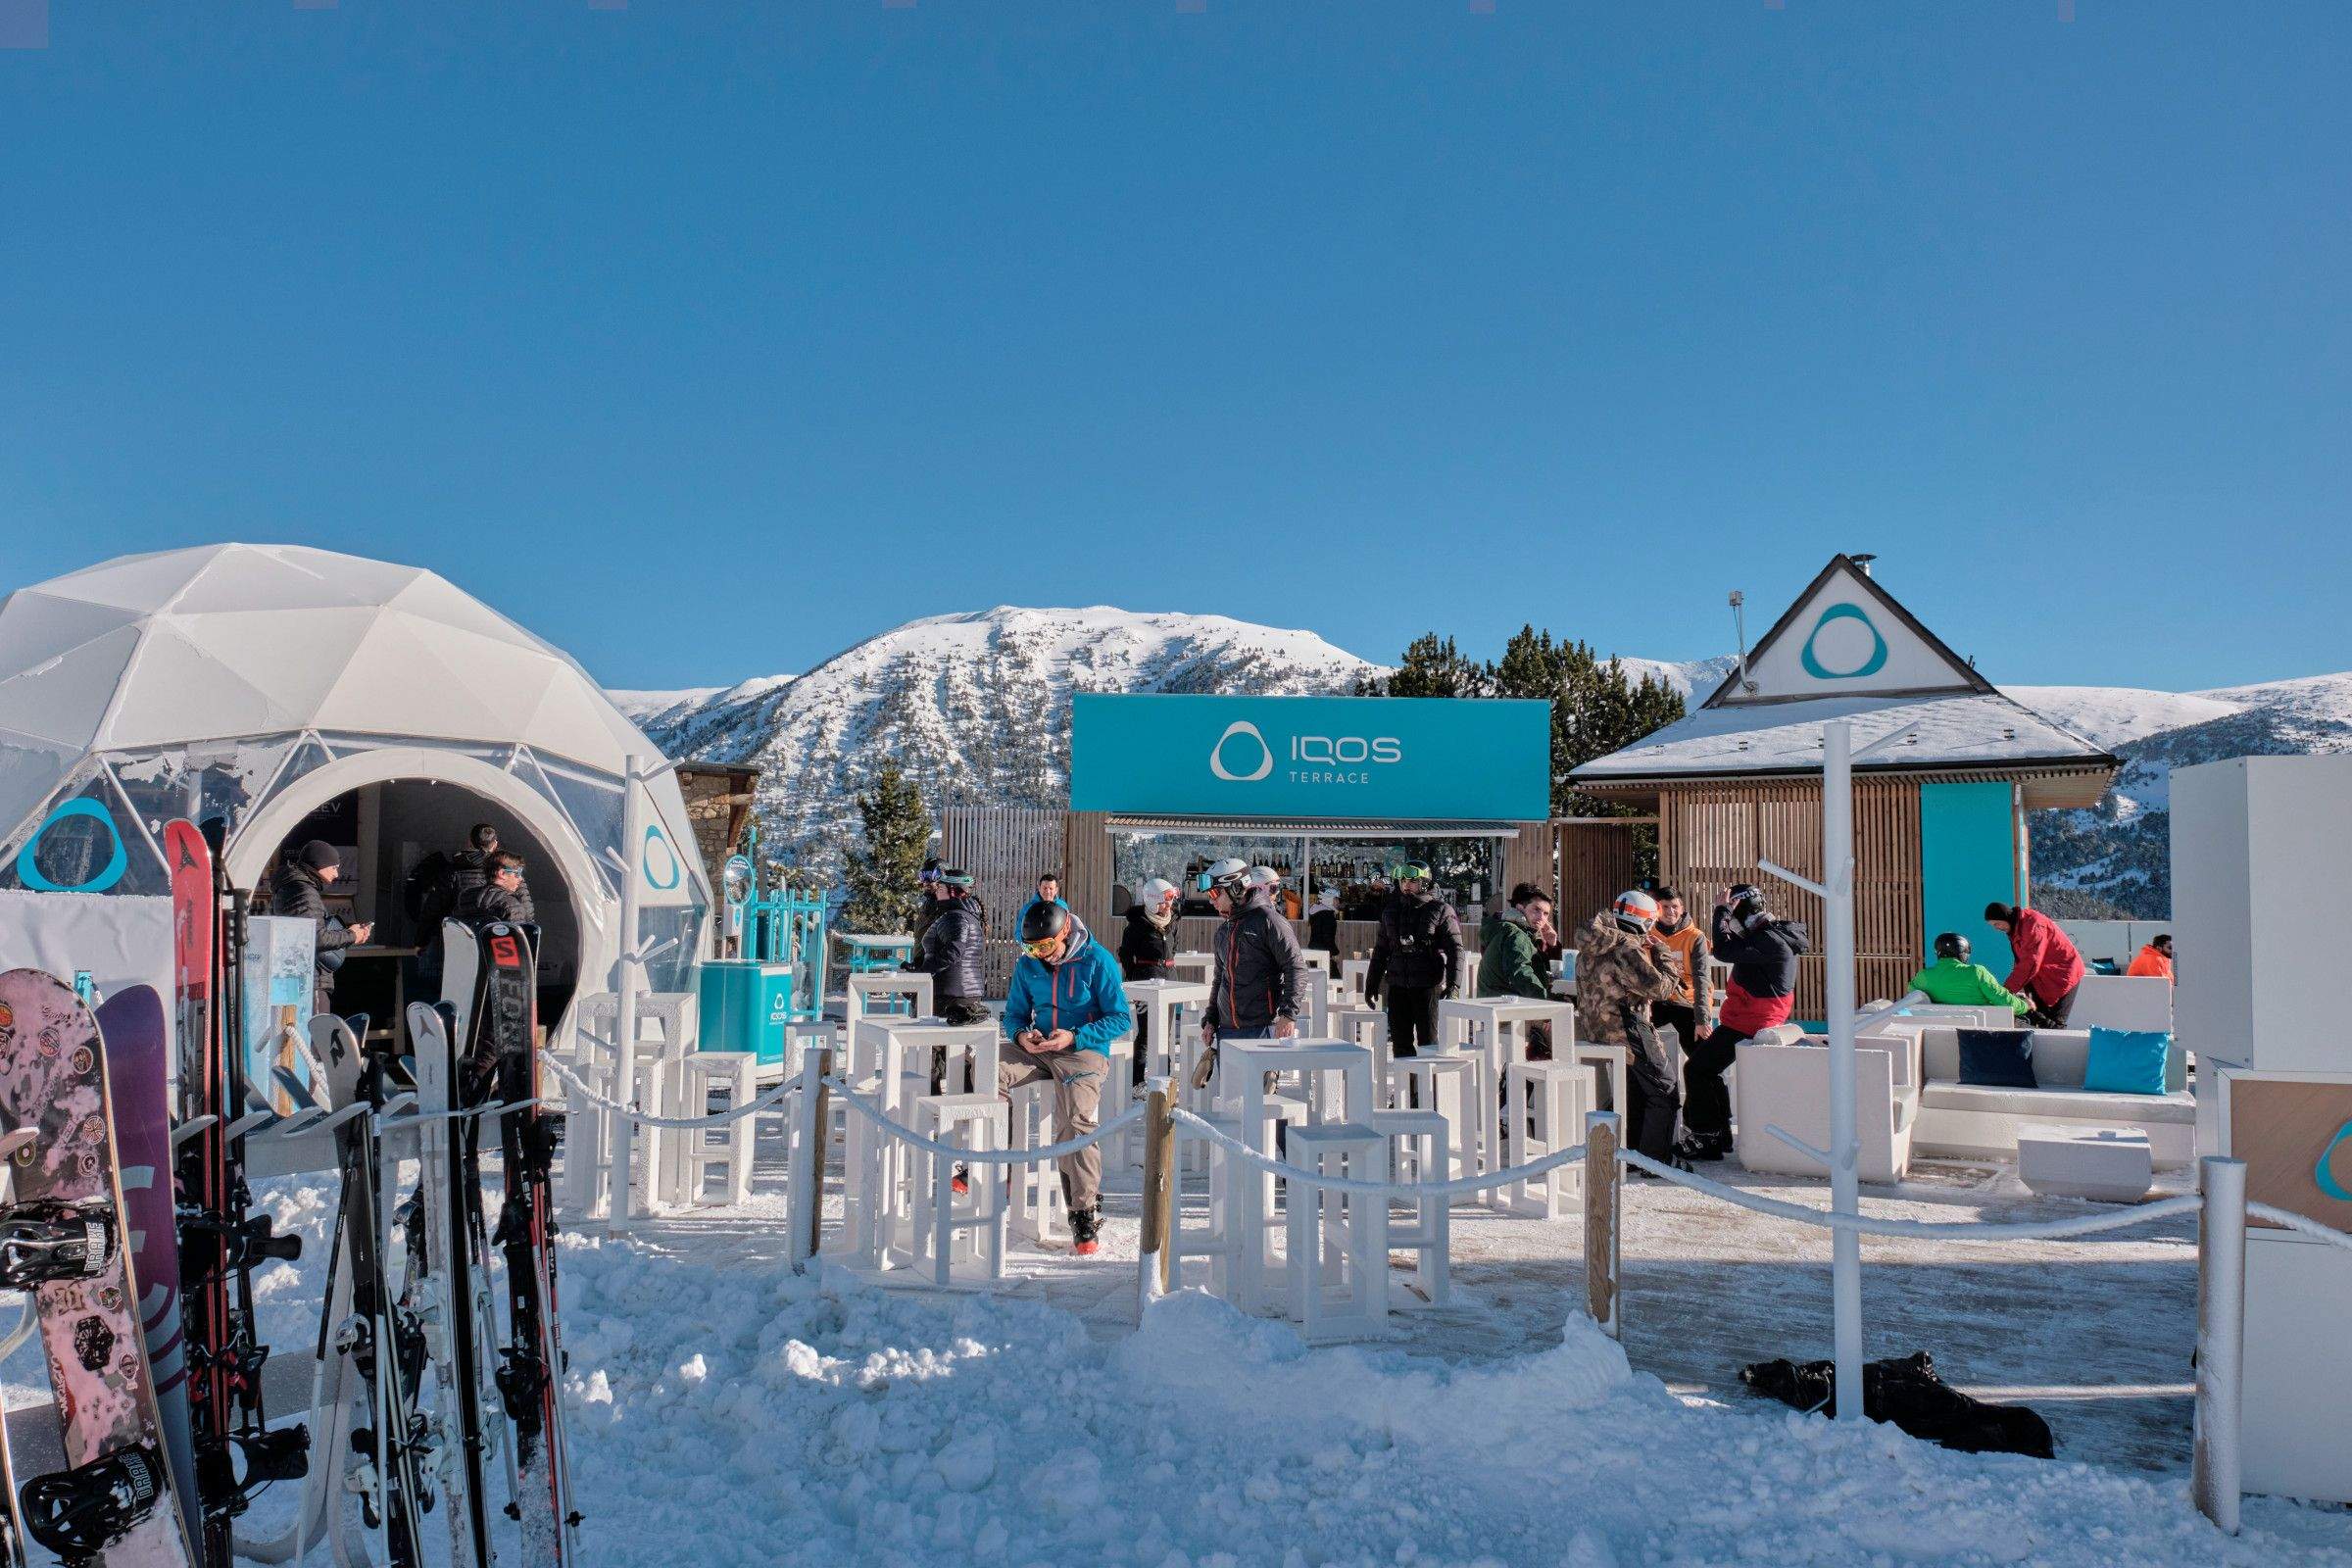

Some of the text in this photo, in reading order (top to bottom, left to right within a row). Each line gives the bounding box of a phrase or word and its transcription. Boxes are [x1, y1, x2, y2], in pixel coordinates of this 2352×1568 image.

[1292, 736, 1402, 766] IQOS
[1290, 771, 1369, 784] TERRACE
[520, 1171, 533, 1209] LEKI
[84, 1222, 105, 1271] DRAKE
[120, 1451, 154, 1500] DRAKE
